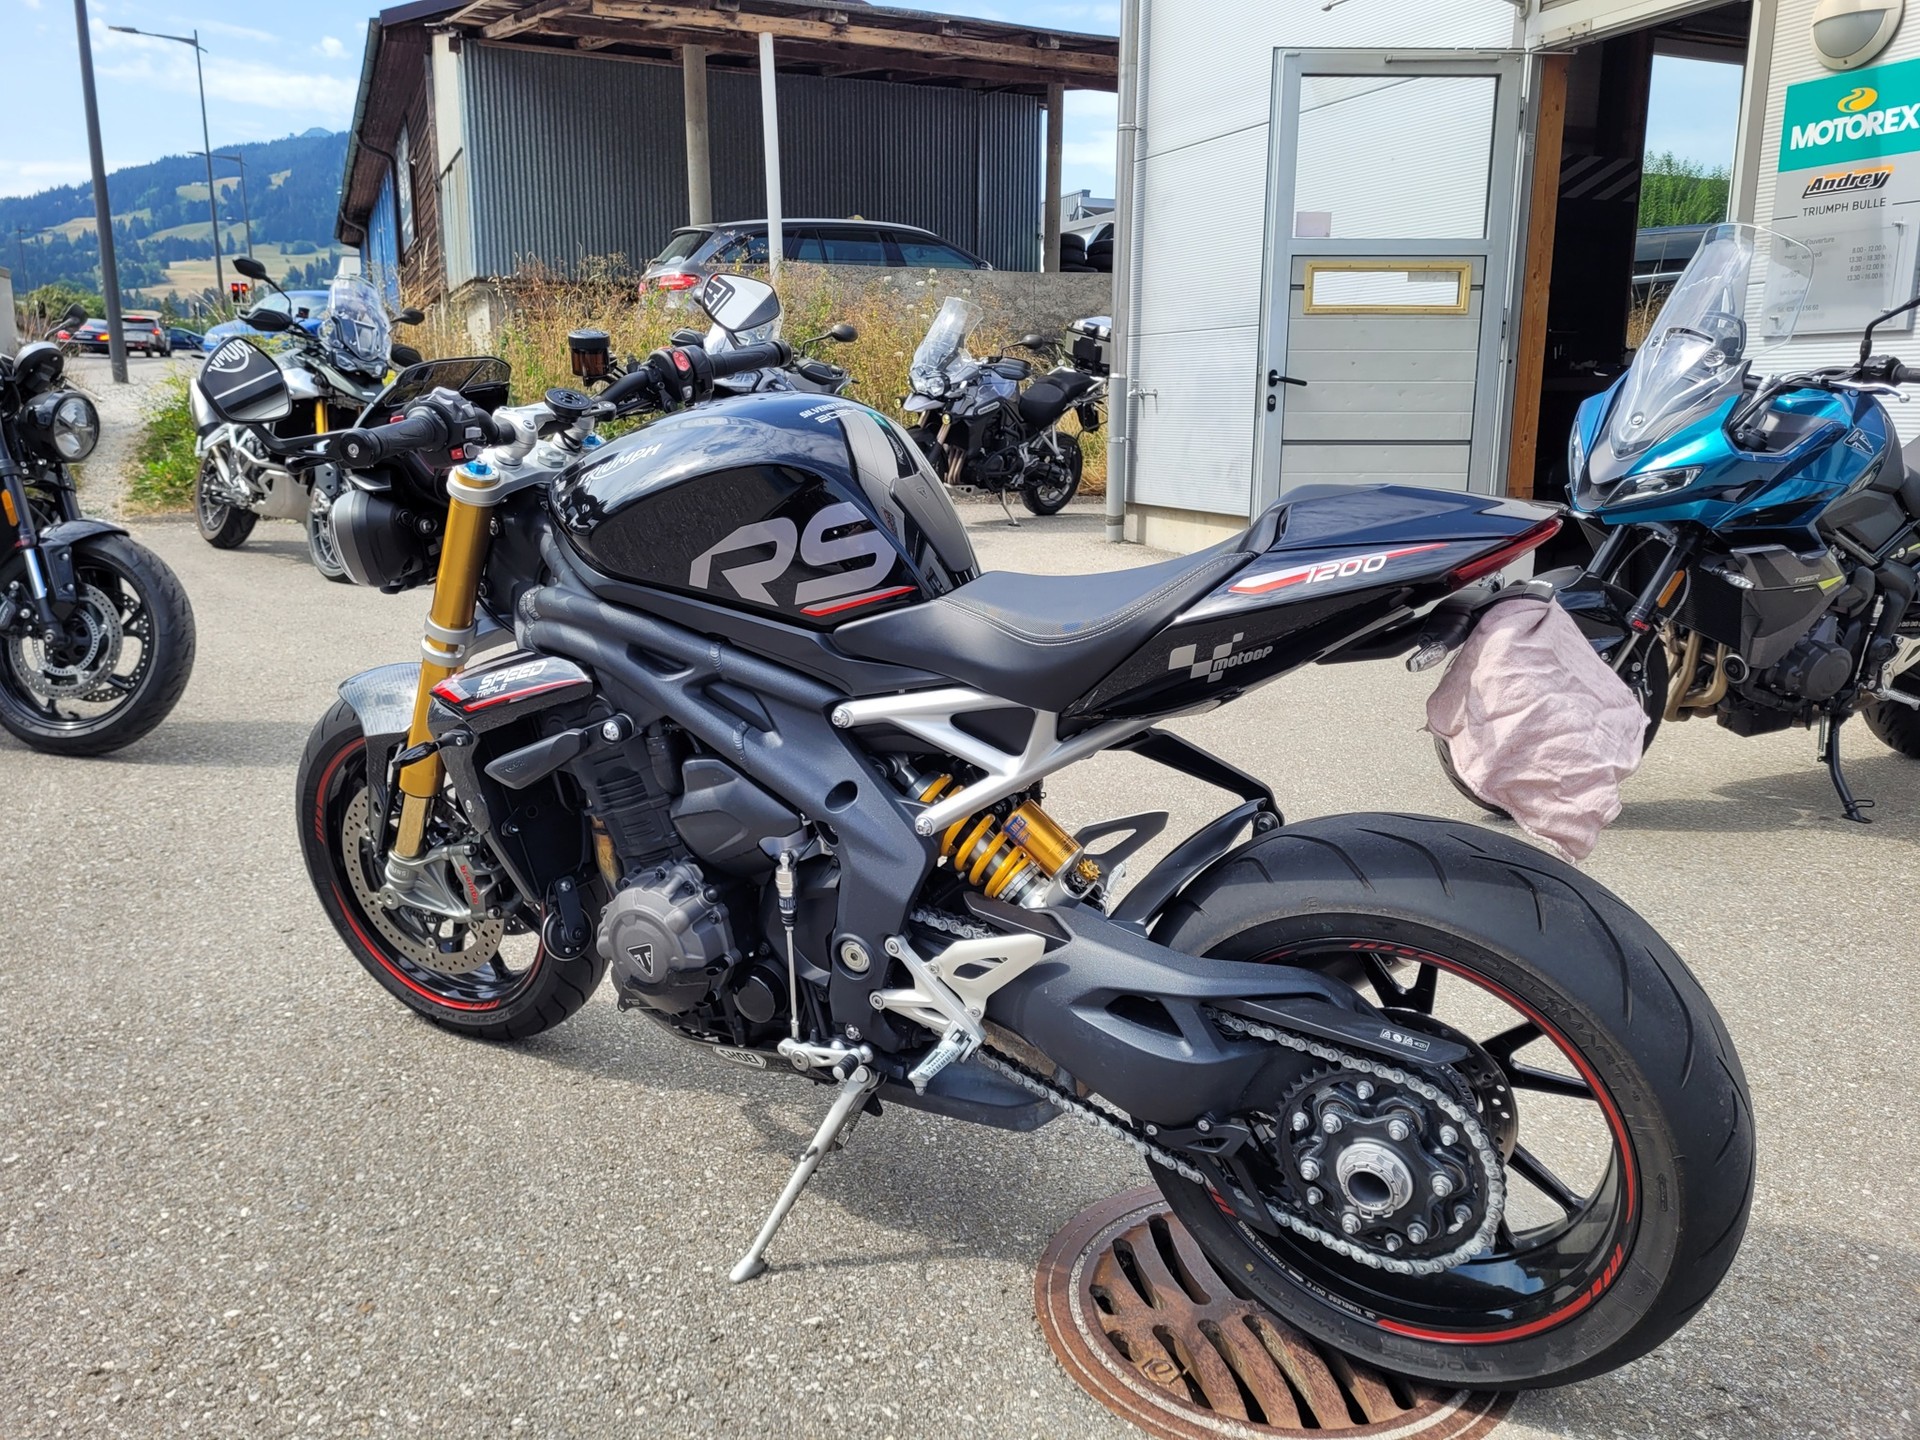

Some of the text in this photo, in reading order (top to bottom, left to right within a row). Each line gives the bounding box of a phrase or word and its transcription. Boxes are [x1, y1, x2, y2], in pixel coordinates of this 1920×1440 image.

[1789, 102, 1920, 151] MOTOREX
[1807, 170, 1889, 193] Andrey
[1802, 197, 1887, 217] TRIUMPH BULLE
[577, 443, 662, 486] TRIUMPH
[689, 501, 897, 607] RS
[1305, 555, 1388, 584] 1200
[478, 660, 548, 690] SPEED
[476, 683, 508, 698] TRIPLE
[460, 864, 479, 905] brembo
[719, 1049, 761, 1065] SHOEI
[1312, 1284, 1326, 1297] DOT
[1328, 1294, 1362, 1315] TUBELESS
